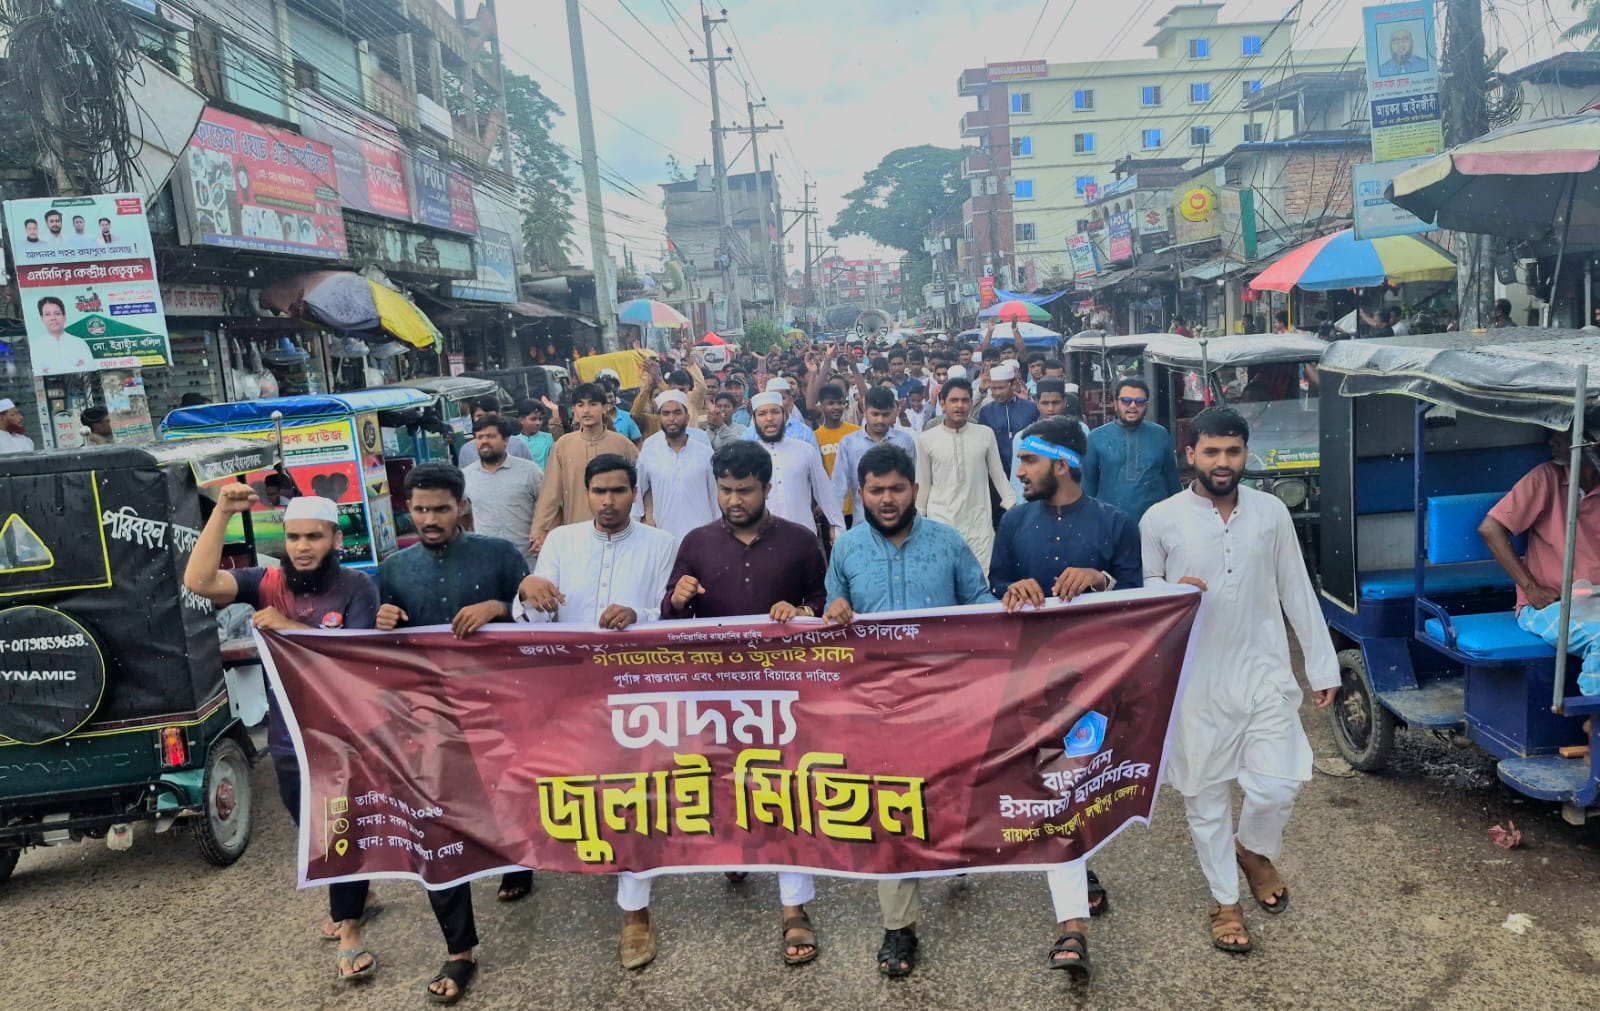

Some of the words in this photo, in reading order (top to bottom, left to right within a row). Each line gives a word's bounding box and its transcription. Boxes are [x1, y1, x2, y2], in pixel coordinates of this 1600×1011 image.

[1401, 94, 1436, 113] আইনজীবী
[853, 622, 921, 641] উপলক্ষে
[593, 647, 685, 667] গণভোটের
[687, 651, 724, 666] রায়
[729, 651, 744, 663] ও
[747, 647, 806, 668] জুলাই
[810, 646, 855, 664] সনদ
[0, 670, 77, 681] YNAMIC
[643, 672, 687, 684] বাস্তবায়ন
[691, 672, 715, 682] এবং
[715, 671, 761, 682] গণহত্যার
[764, 668, 802, 682] বিচারের
[805, 669, 841, 683] দাবিতে
[607, 690, 799, 749] অদম্য
[999, 791, 1071, 819] ইসলামী
[1074, 760, 1151, 804] ছাত্রশিবির
[536, 752, 714, 863] জুলাই
[733, 748, 929, 841] মিছিল
